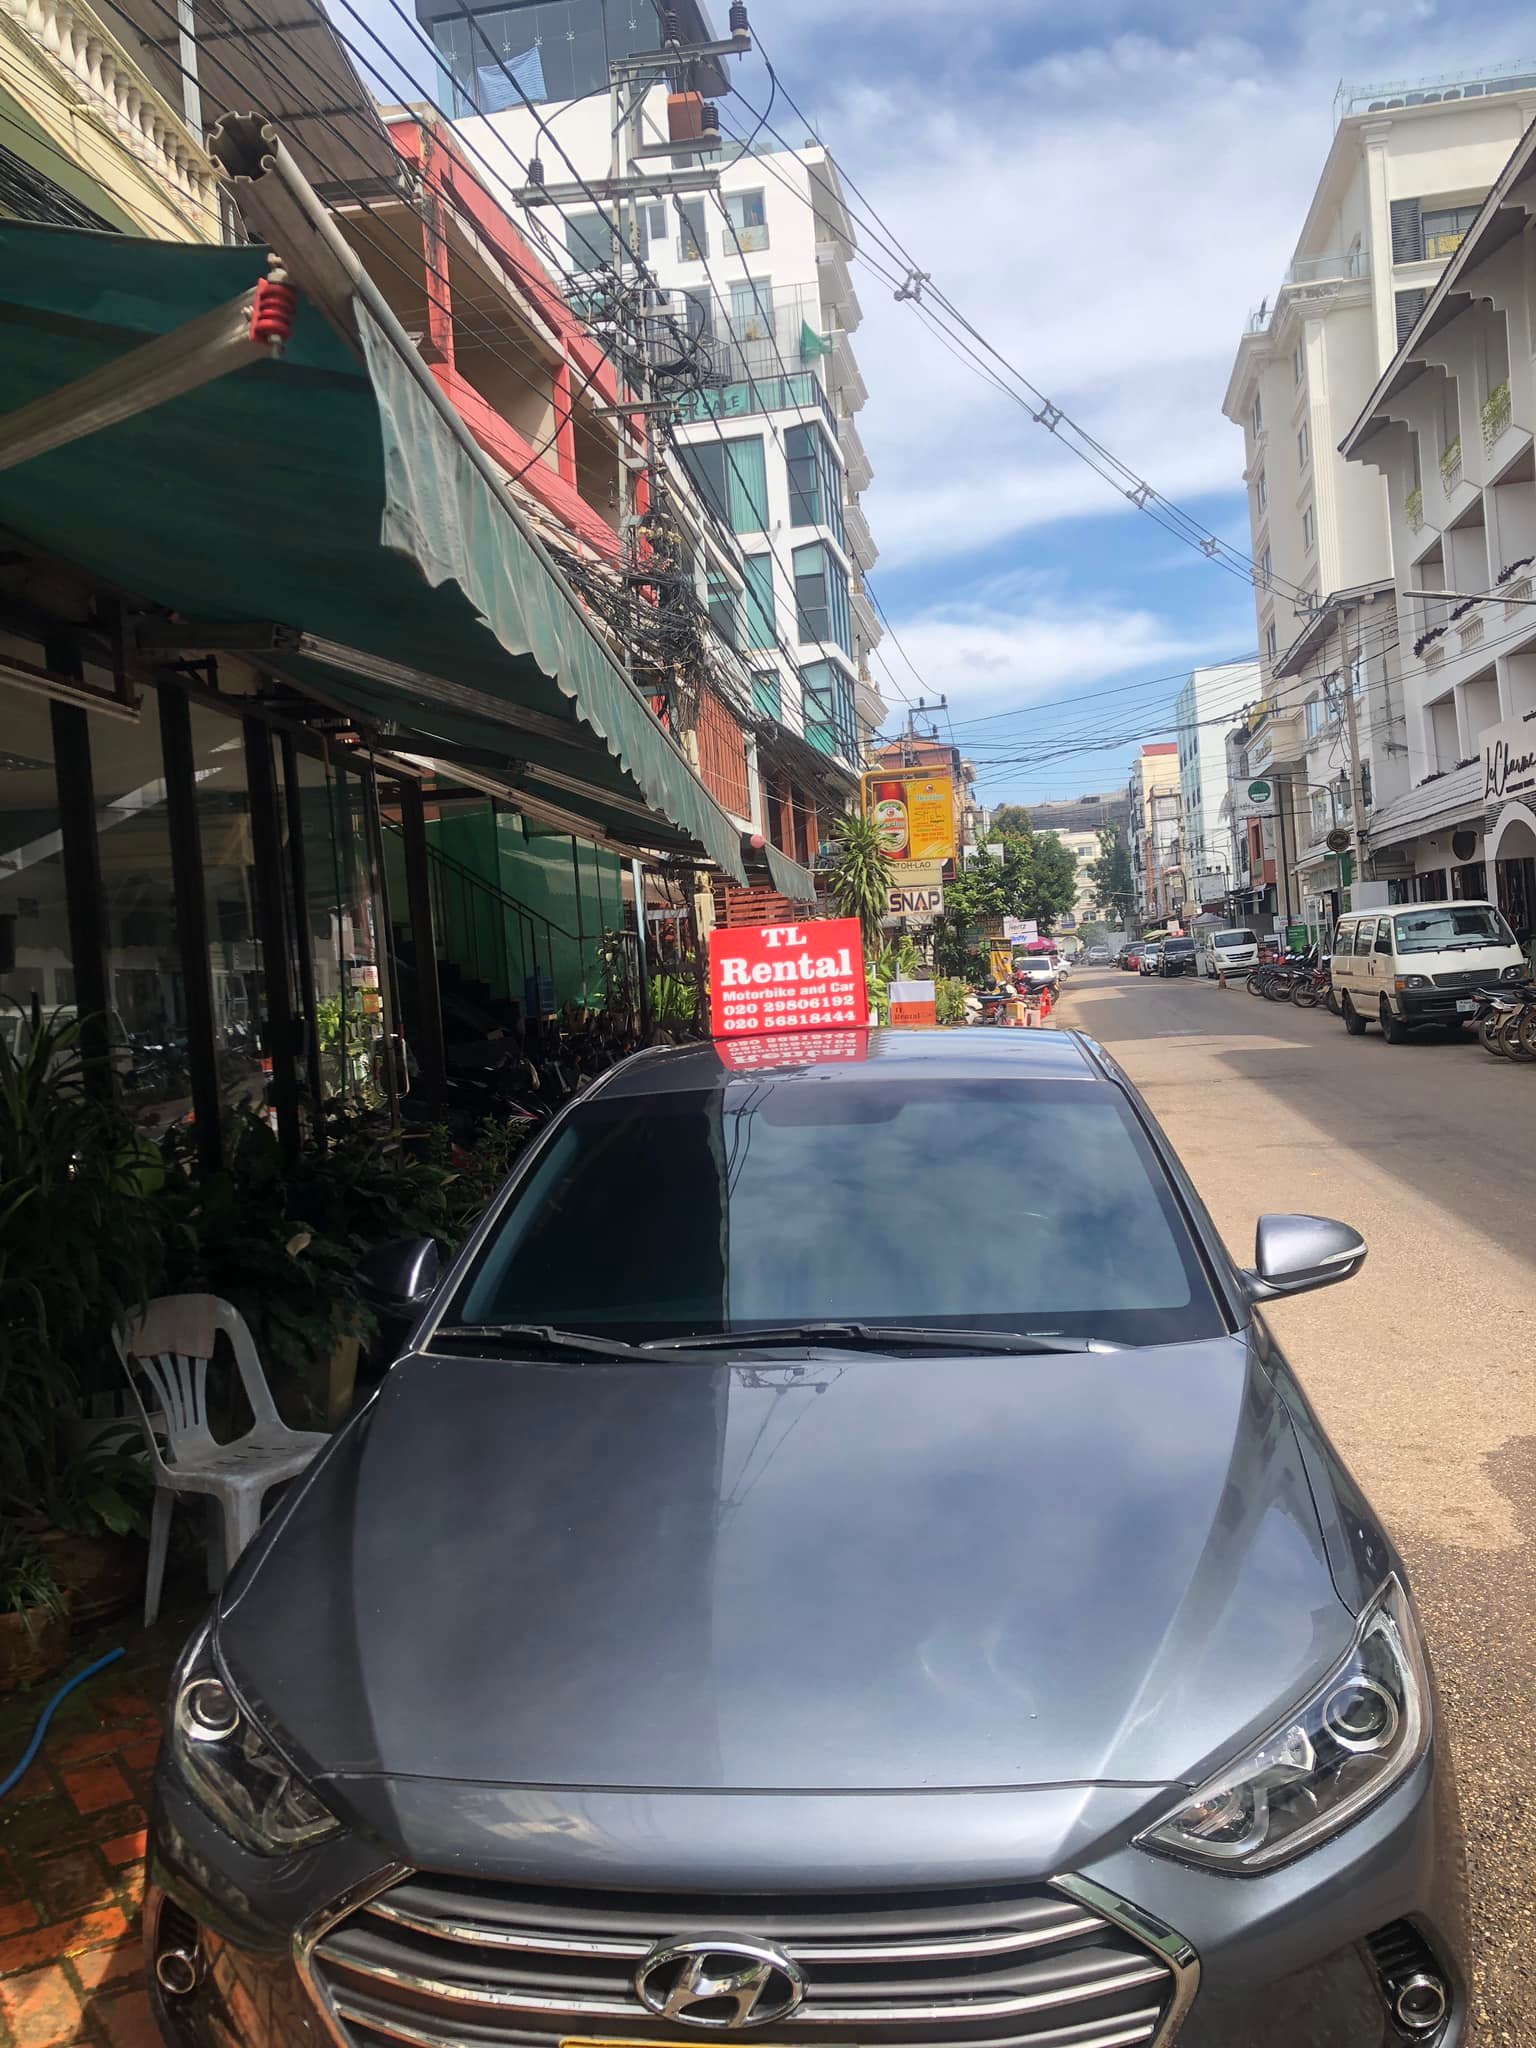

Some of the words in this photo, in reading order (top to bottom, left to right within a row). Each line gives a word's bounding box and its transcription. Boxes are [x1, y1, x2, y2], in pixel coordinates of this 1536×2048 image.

[702, 395, 740, 416] SALE
[889, 891, 940, 912] SNAP
[761, 926, 807, 948] TL
[720, 949, 853, 986] Rental
[722, 987, 796, 1002] Motorbike
[800, 983, 826, 996] and
[830, 982, 855, 993] Car
[723, 1003, 758, 1016] 020
[763, 995, 855, 1013] 29806192
[723, 1017, 758, 1030] 020
[764, 1011, 856, 1028] 56818444
